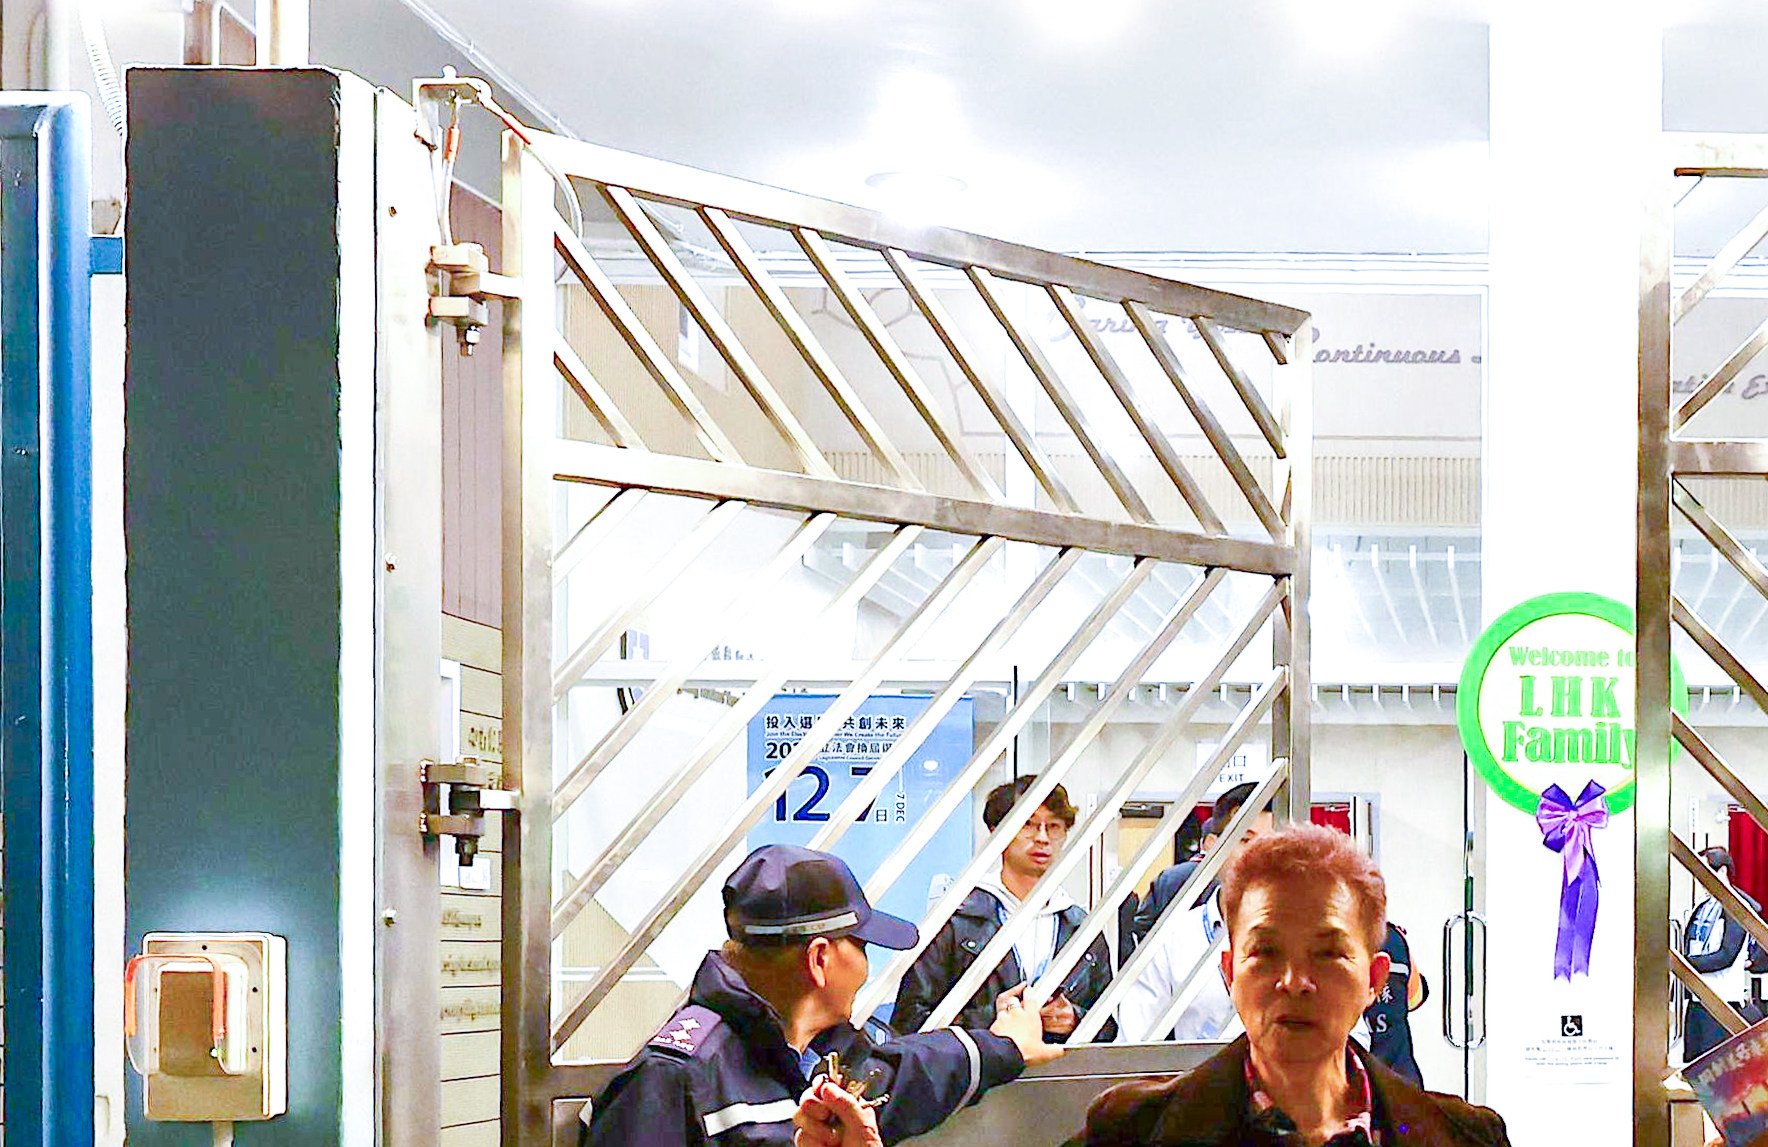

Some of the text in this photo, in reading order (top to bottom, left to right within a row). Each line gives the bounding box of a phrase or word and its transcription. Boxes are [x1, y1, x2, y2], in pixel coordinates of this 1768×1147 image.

[1310, 328, 1461, 364] ontinuous
[1509, 646, 1611, 668] Welcome
[1502, 720, 1636, 770] Family
[1219, 773, 1245, 783] EXIT
